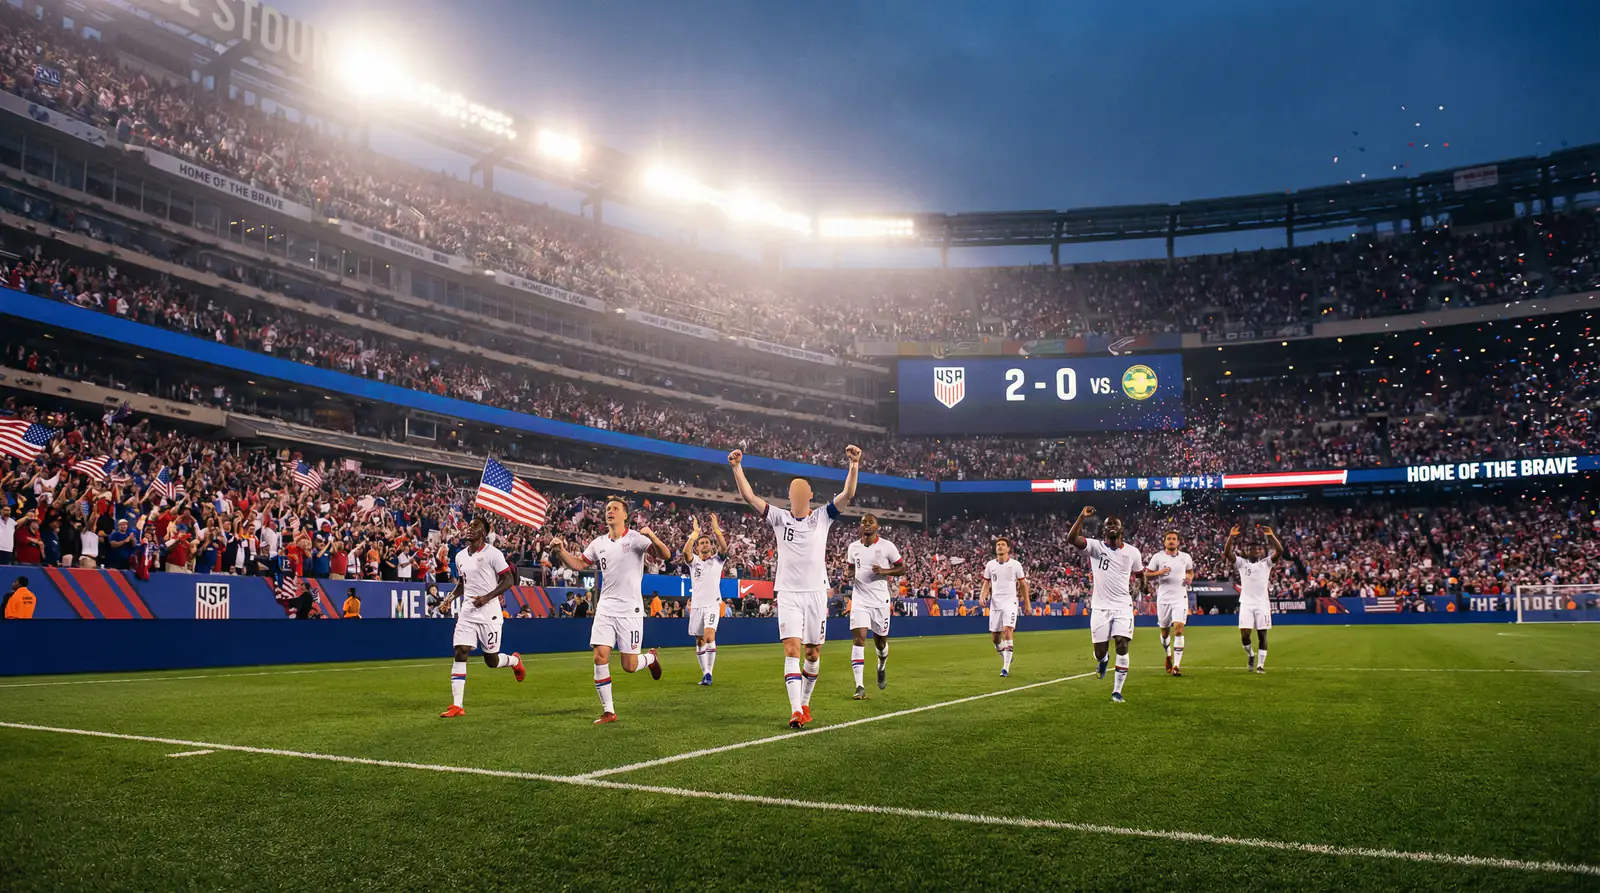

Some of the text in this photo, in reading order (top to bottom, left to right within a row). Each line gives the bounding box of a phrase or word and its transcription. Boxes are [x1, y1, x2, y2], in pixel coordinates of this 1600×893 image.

[180, 163, 284, 211] HOME OF THE BRAVE
[936, 369, 962, 384] USA
[1005, 368, 1025, 401] 2
[1056, 367, 1076, 401] 0
[1407, 456, 1578, 482] HOME OF THE BRAVE
[783, 526, 794, 542] 16
[198, 585, 228, 605] USA
